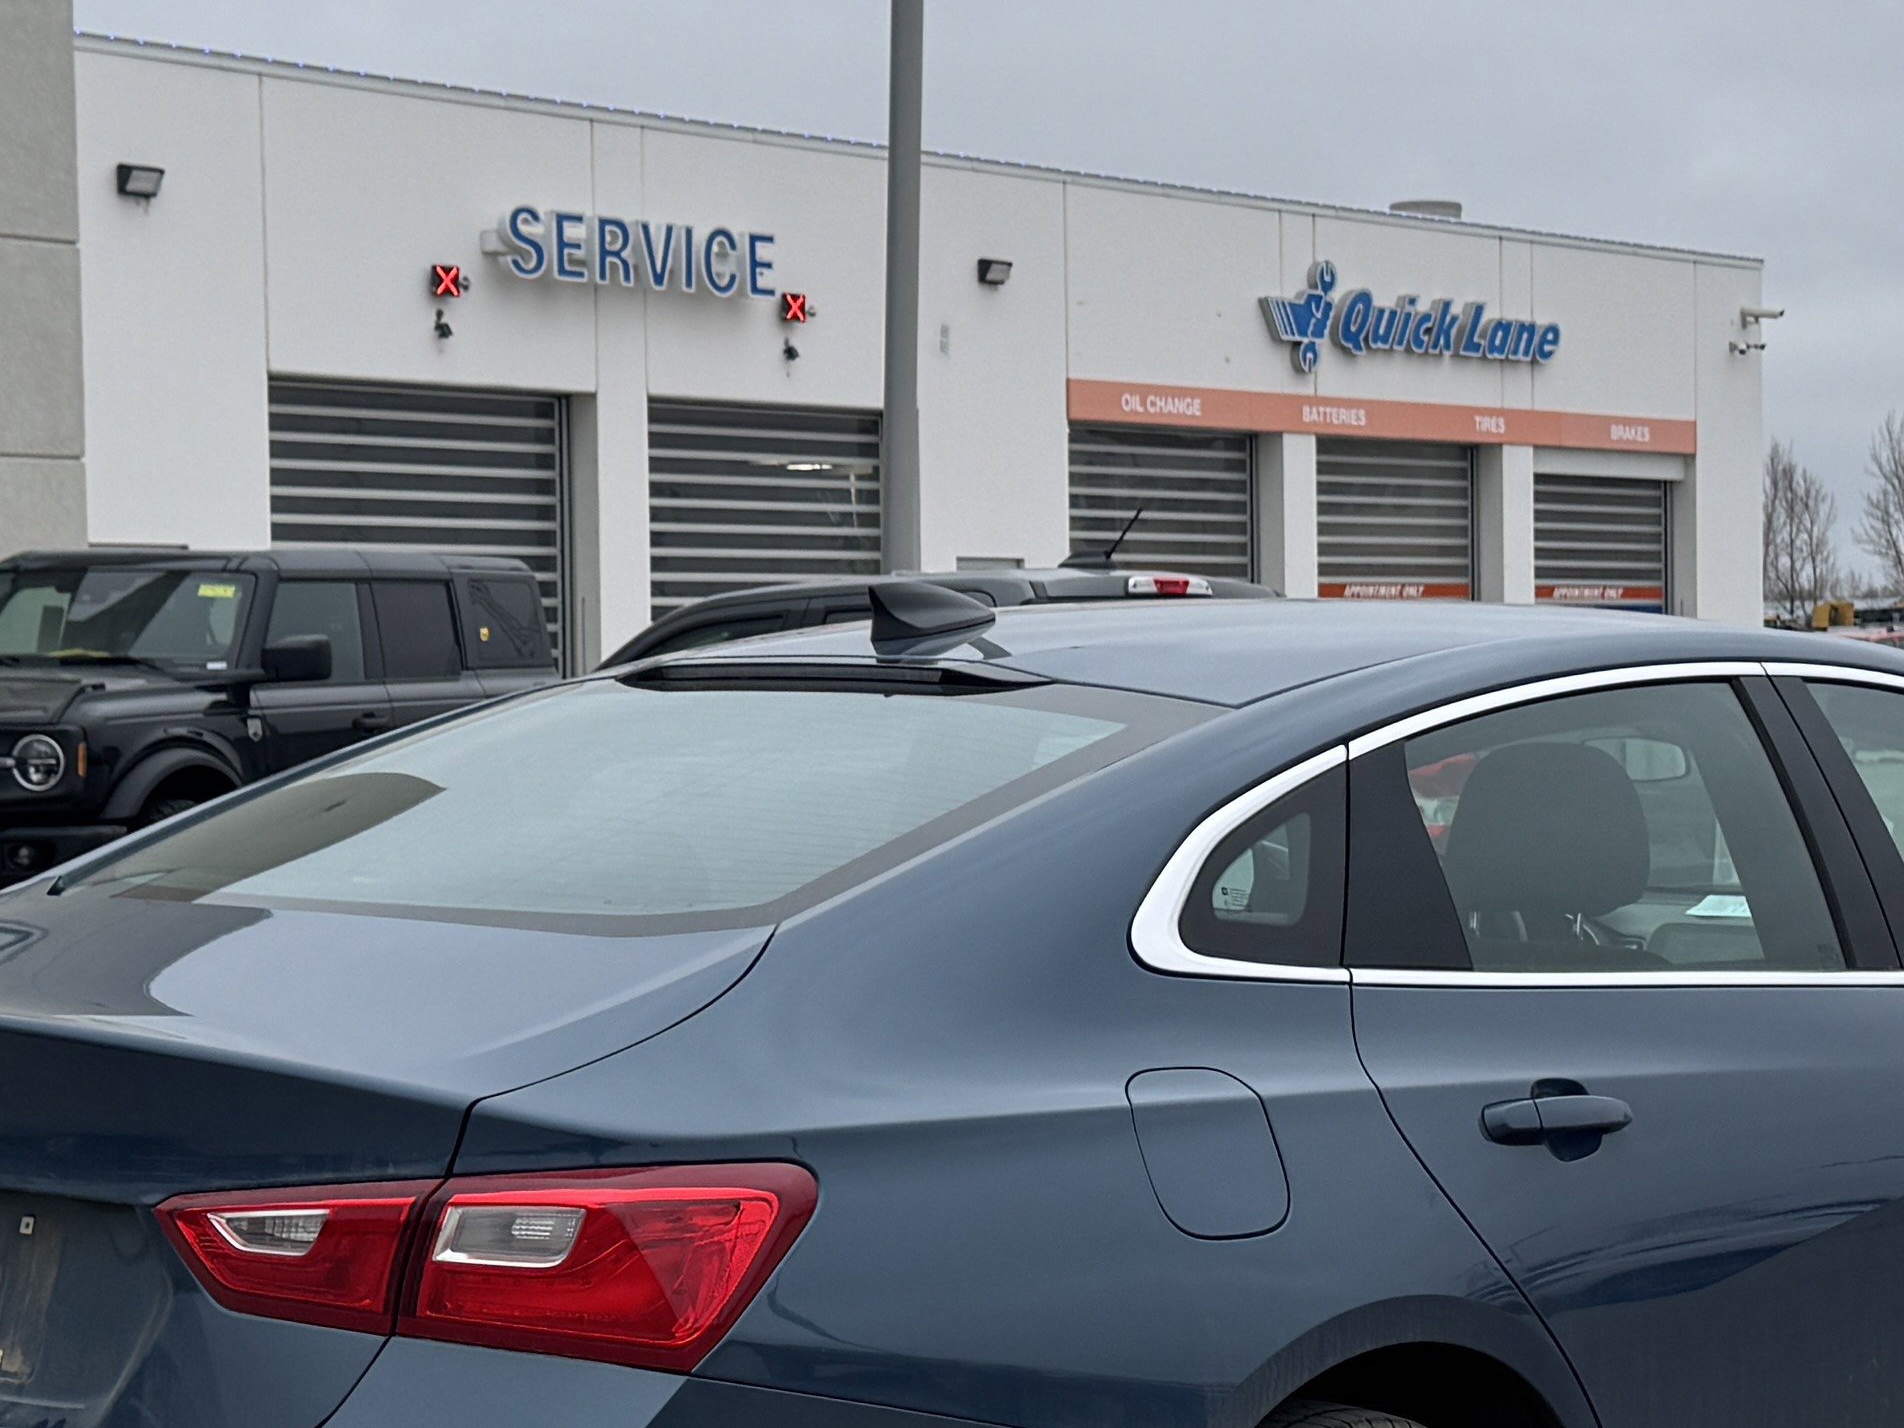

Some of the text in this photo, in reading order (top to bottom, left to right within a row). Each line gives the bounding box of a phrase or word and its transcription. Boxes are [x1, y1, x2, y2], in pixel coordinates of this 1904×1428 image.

[506, 203, 778, 300] SERVICE
[1121, 393, 1202, 417] OIL CHANGE
[1302, 405, 1366, 427] BATTERIES
[1473, 415, 1506, 434] TIRES
[1610, 423, 1650, 443] BRAKES
